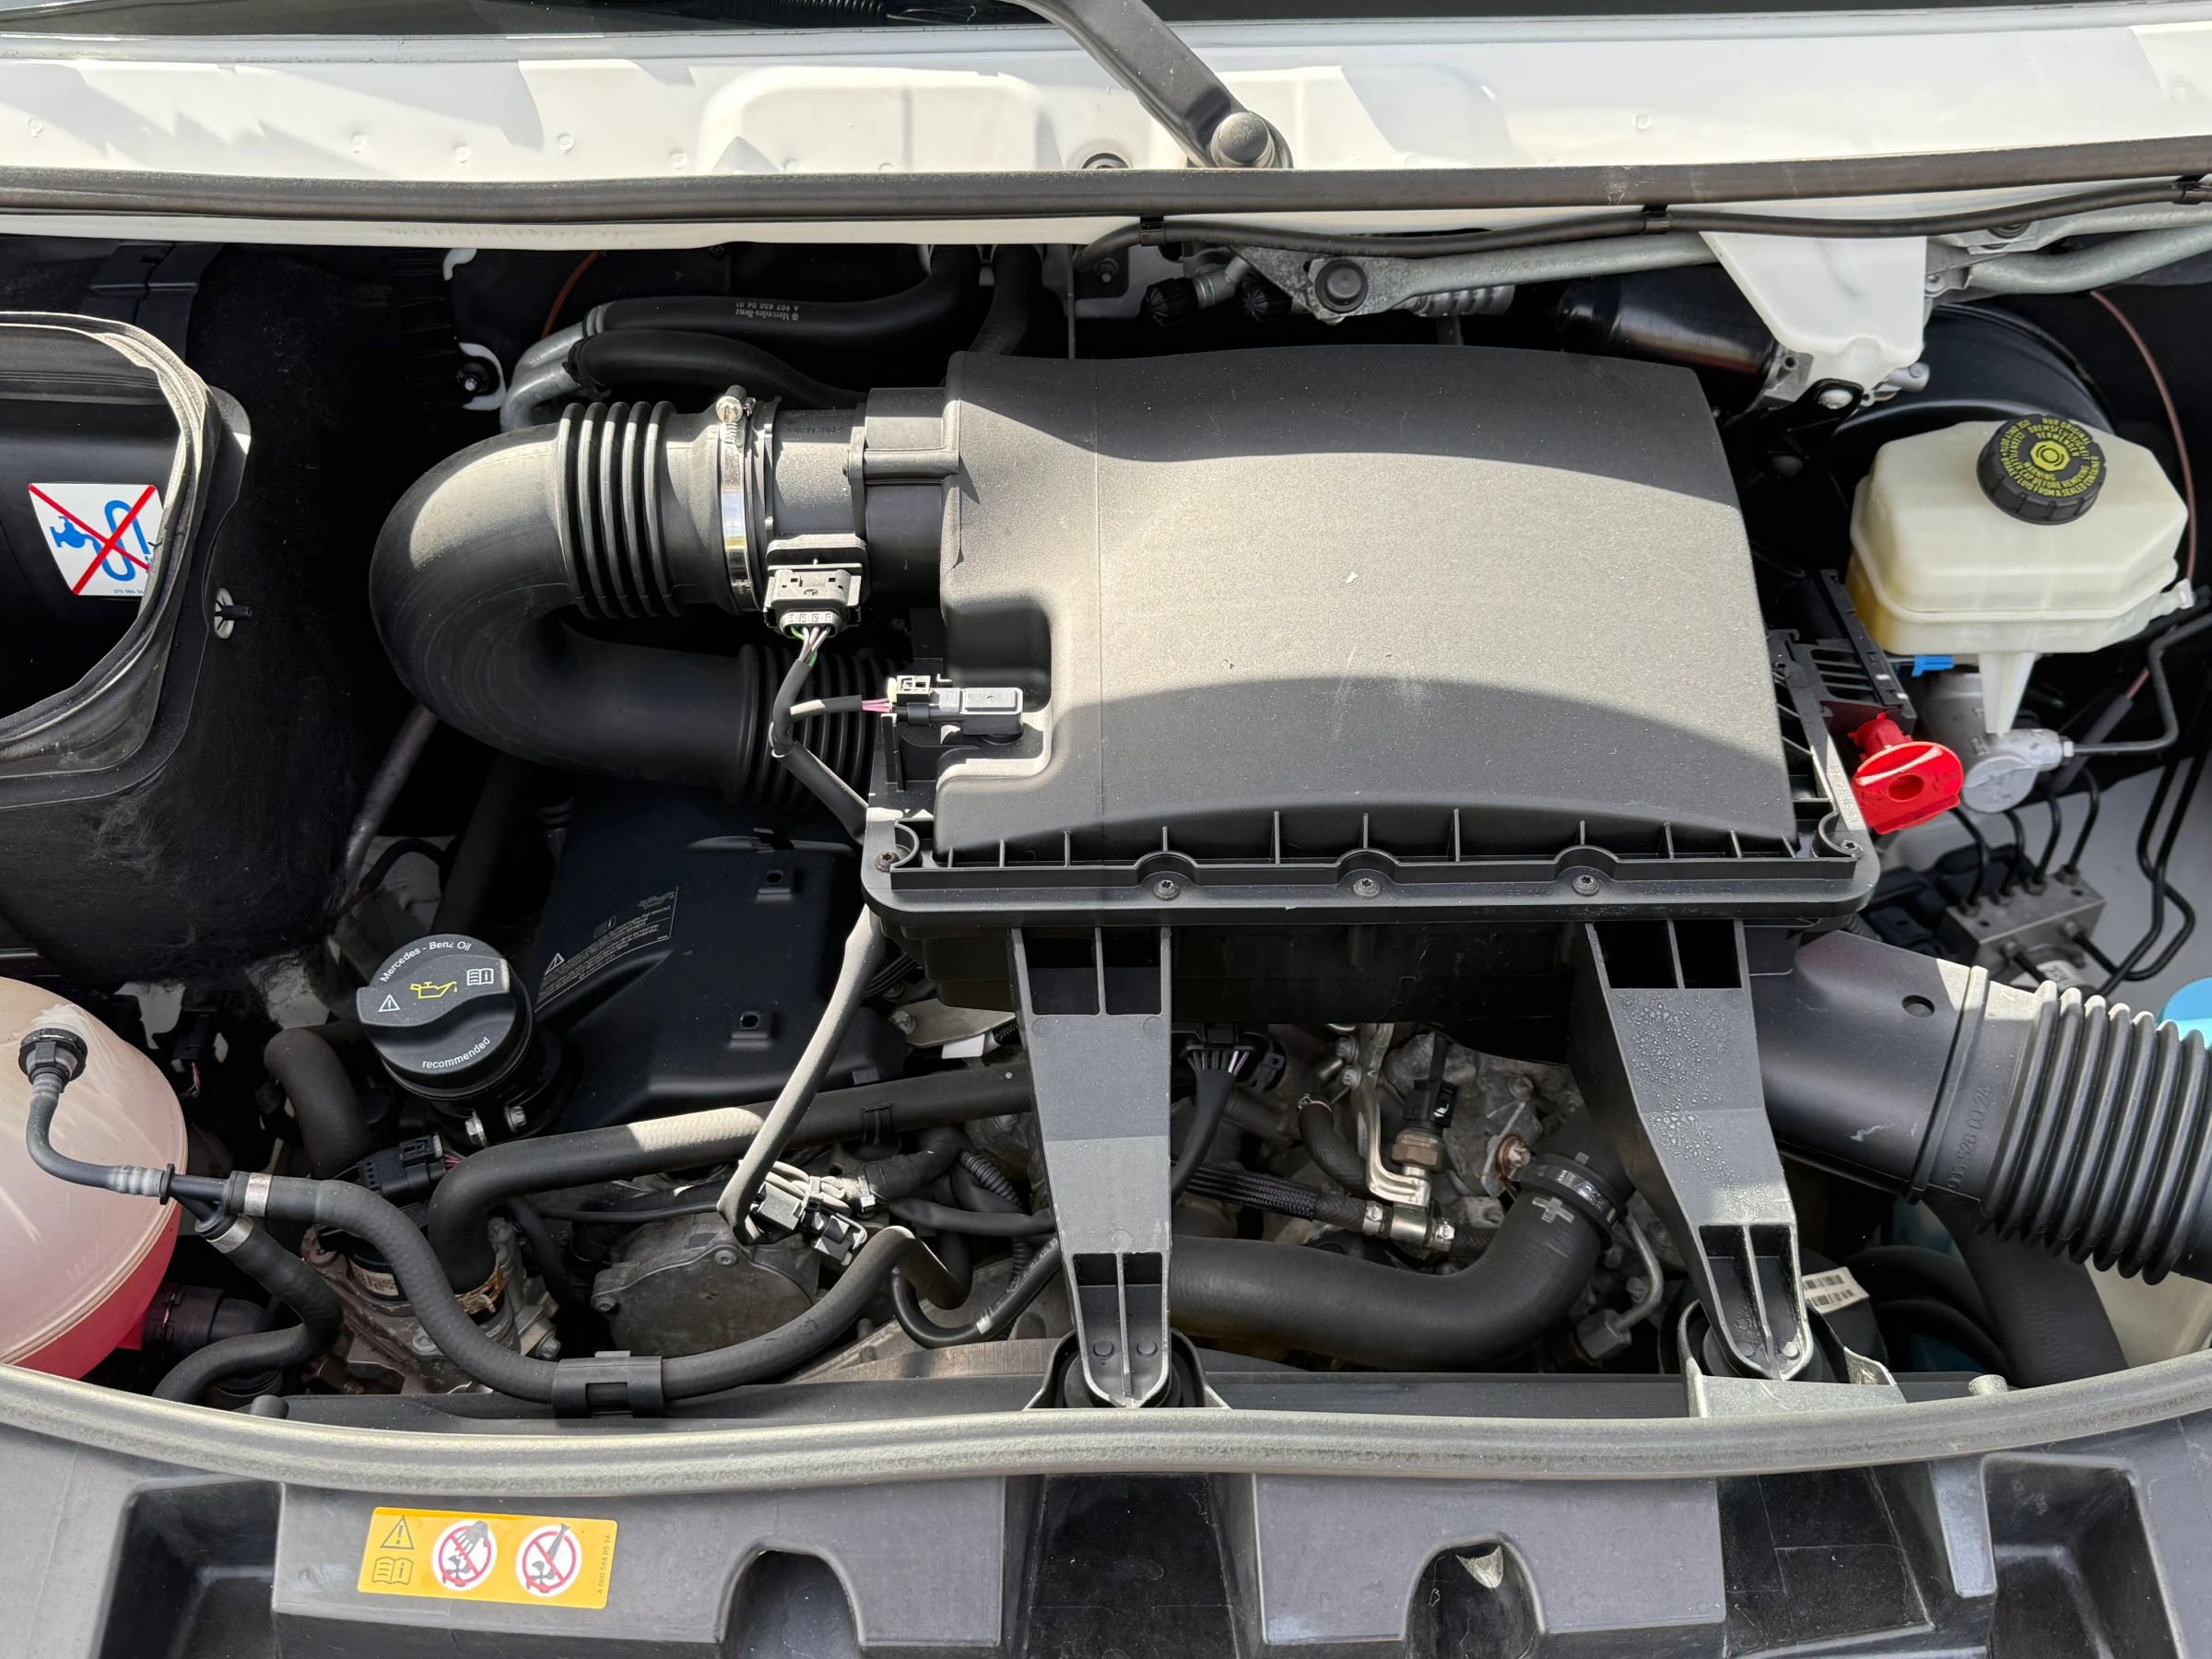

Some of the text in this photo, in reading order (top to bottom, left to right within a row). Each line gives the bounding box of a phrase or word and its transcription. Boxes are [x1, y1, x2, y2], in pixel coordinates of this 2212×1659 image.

[735, 309, 790, 320] Mercedes-Benz
[2060, 421, 2091, 445] ORIGINAL
[2000, 456, 2017, 480] BRAKE
[2017, 476, 2033, 490] FLUID
[2033, 486, 2055, 497] FROM
[2062, 483, 2087, 497] SEALED
[2018, 467, 2034, 481] CAP
[2032, 477, 2063, 488] BEFORE
[2022, 461, 2056, 481] WARNING
[379, 947, 421, 982] Mercedes
[429, 941, 454, 950] Benz
[457, 941, 472, 951] Oil
[422, 1037, 490, 1068] recommended
